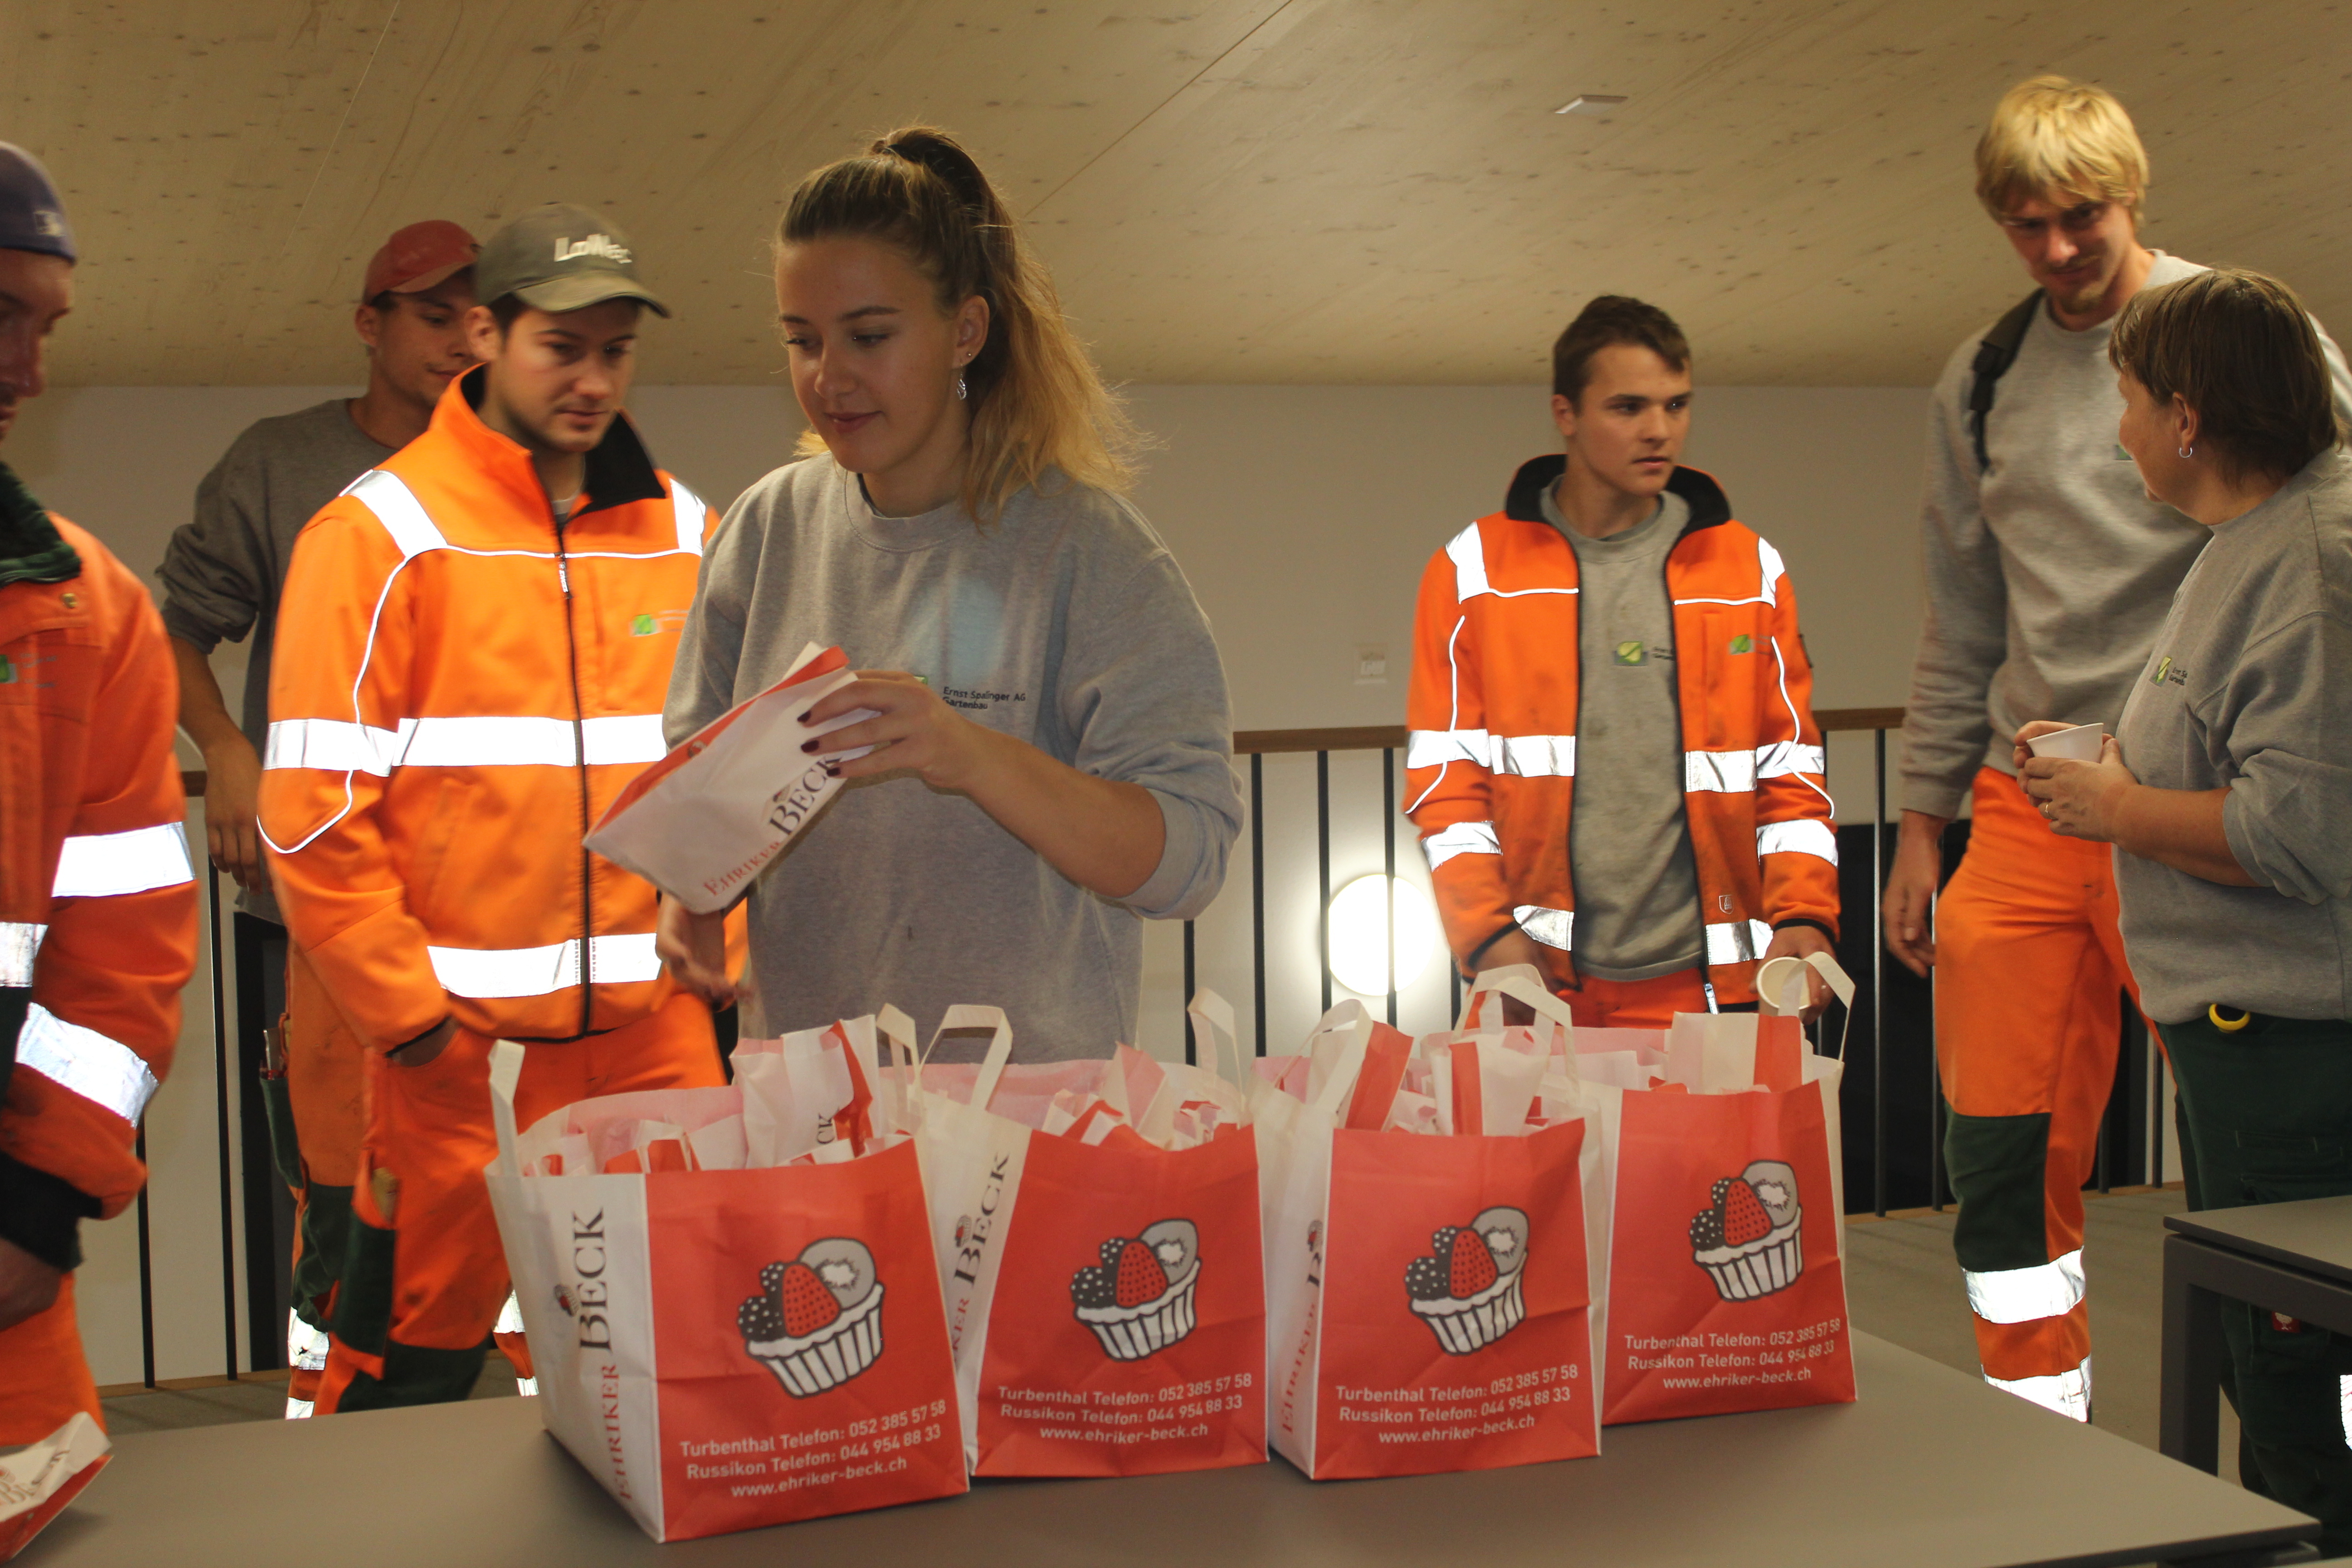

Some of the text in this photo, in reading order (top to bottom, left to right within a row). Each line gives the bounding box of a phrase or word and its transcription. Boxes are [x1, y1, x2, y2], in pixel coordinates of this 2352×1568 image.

[943, 686, 968, 698] Ernst
[1014, 693, 1026, 701] AG
[769, 757, 843, 835] BECK
[817, 1107, 839, 1144] CK
[954, 1152, 1009, 1288] BECK
[572, 1206, 613, 1354] BECK
[1624, 1318, 1840, 1349] Turbenthal Telefon: 052 385 57 58
[1628, 1340, 1834, 1369] Russikon Telefon: 044 954 88 33
[998, 1372, 1252, 1406] Turbenthal Telefon: 052 385 57 58
[1336, 1364, 1578, 1402] Turbenthal Telefon: 052 385 57 58
[1663, 1367, 1811, 1388] www.ehriker-beck.ch
[1001, 1394, 1243, 1426] Russikon Telefon: 044 954 88 33
[1340, 1387, 1570, 1423] Russikon Telefon: 044 954 88 33
[681, 1399, 946, 1457] Turbenthal Telefon: 052 385 57 58
[1039, 1423, 1208, 1445] www.ehriker-beck.ch
[1379, 1414, 1535, 1442] www.ehriker-beck.ch
[687, 1423, 941, 1479] Russikon Telefon: 044 954 88 33
[730, 1457, 907, 1497] www.ehriker-beck.ch
